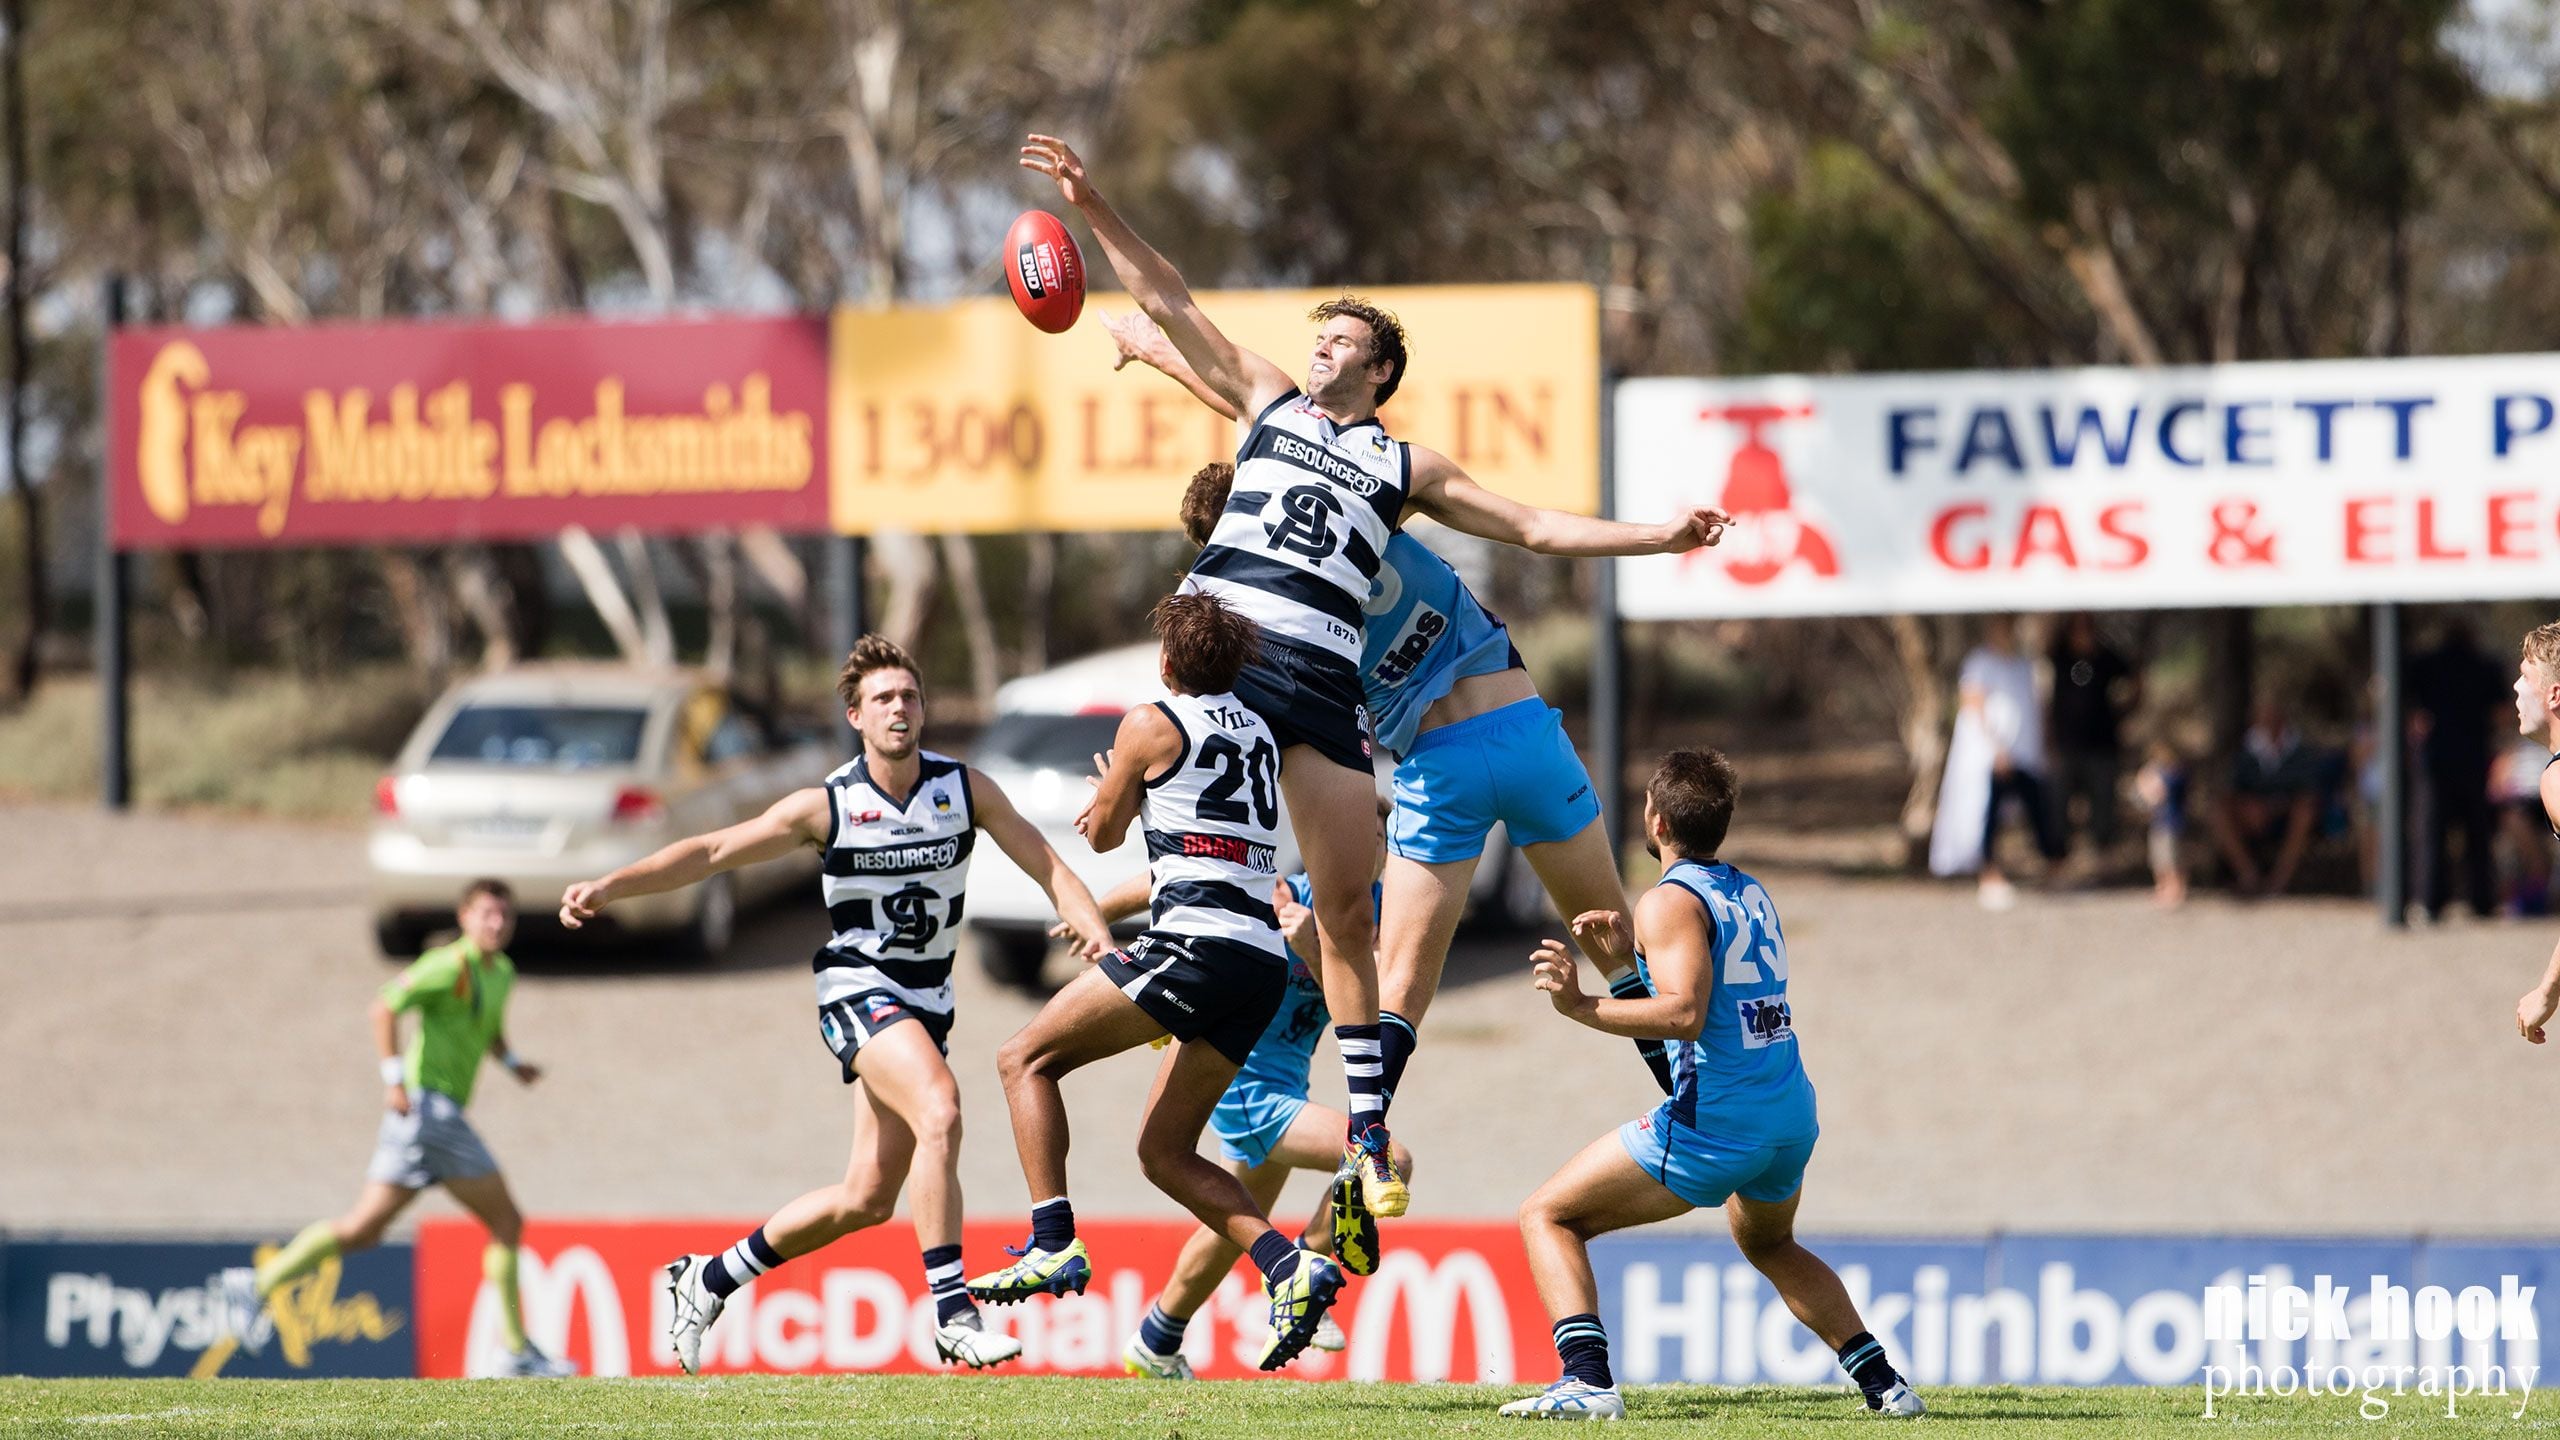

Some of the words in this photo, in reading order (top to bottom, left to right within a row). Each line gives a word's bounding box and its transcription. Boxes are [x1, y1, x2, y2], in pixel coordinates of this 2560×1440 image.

[1021, 253, 1041, 290] END
[1037, 242, 1059, 290] WEST
[191, 389, 300, 538] Key
[304, 378, 499, 500] Mobile
[500, 371, 814, 496] Locksmiths
[862, 400, 1045, 484] 1300
[1886, 396, 2435, 476] FAWCETT
[2493, 395, 2555, 458] P
[1928, 502, 2151, 571] GAS
[2206, 500, 2278, 568] &
[2342, 493, 2560, 562] ELE
[1326, 621, 1356, 645] 1876
[1375, 610, 1445, 682] tips
[1194, 733, 1279, 832] 20
[853, 835, 959, 871] RESOURCECO
[890, 826, 924, 836] NELSON
[1710, 883, 1789, 985] 23
[1161, 988, 1195, 1014] NELSON
